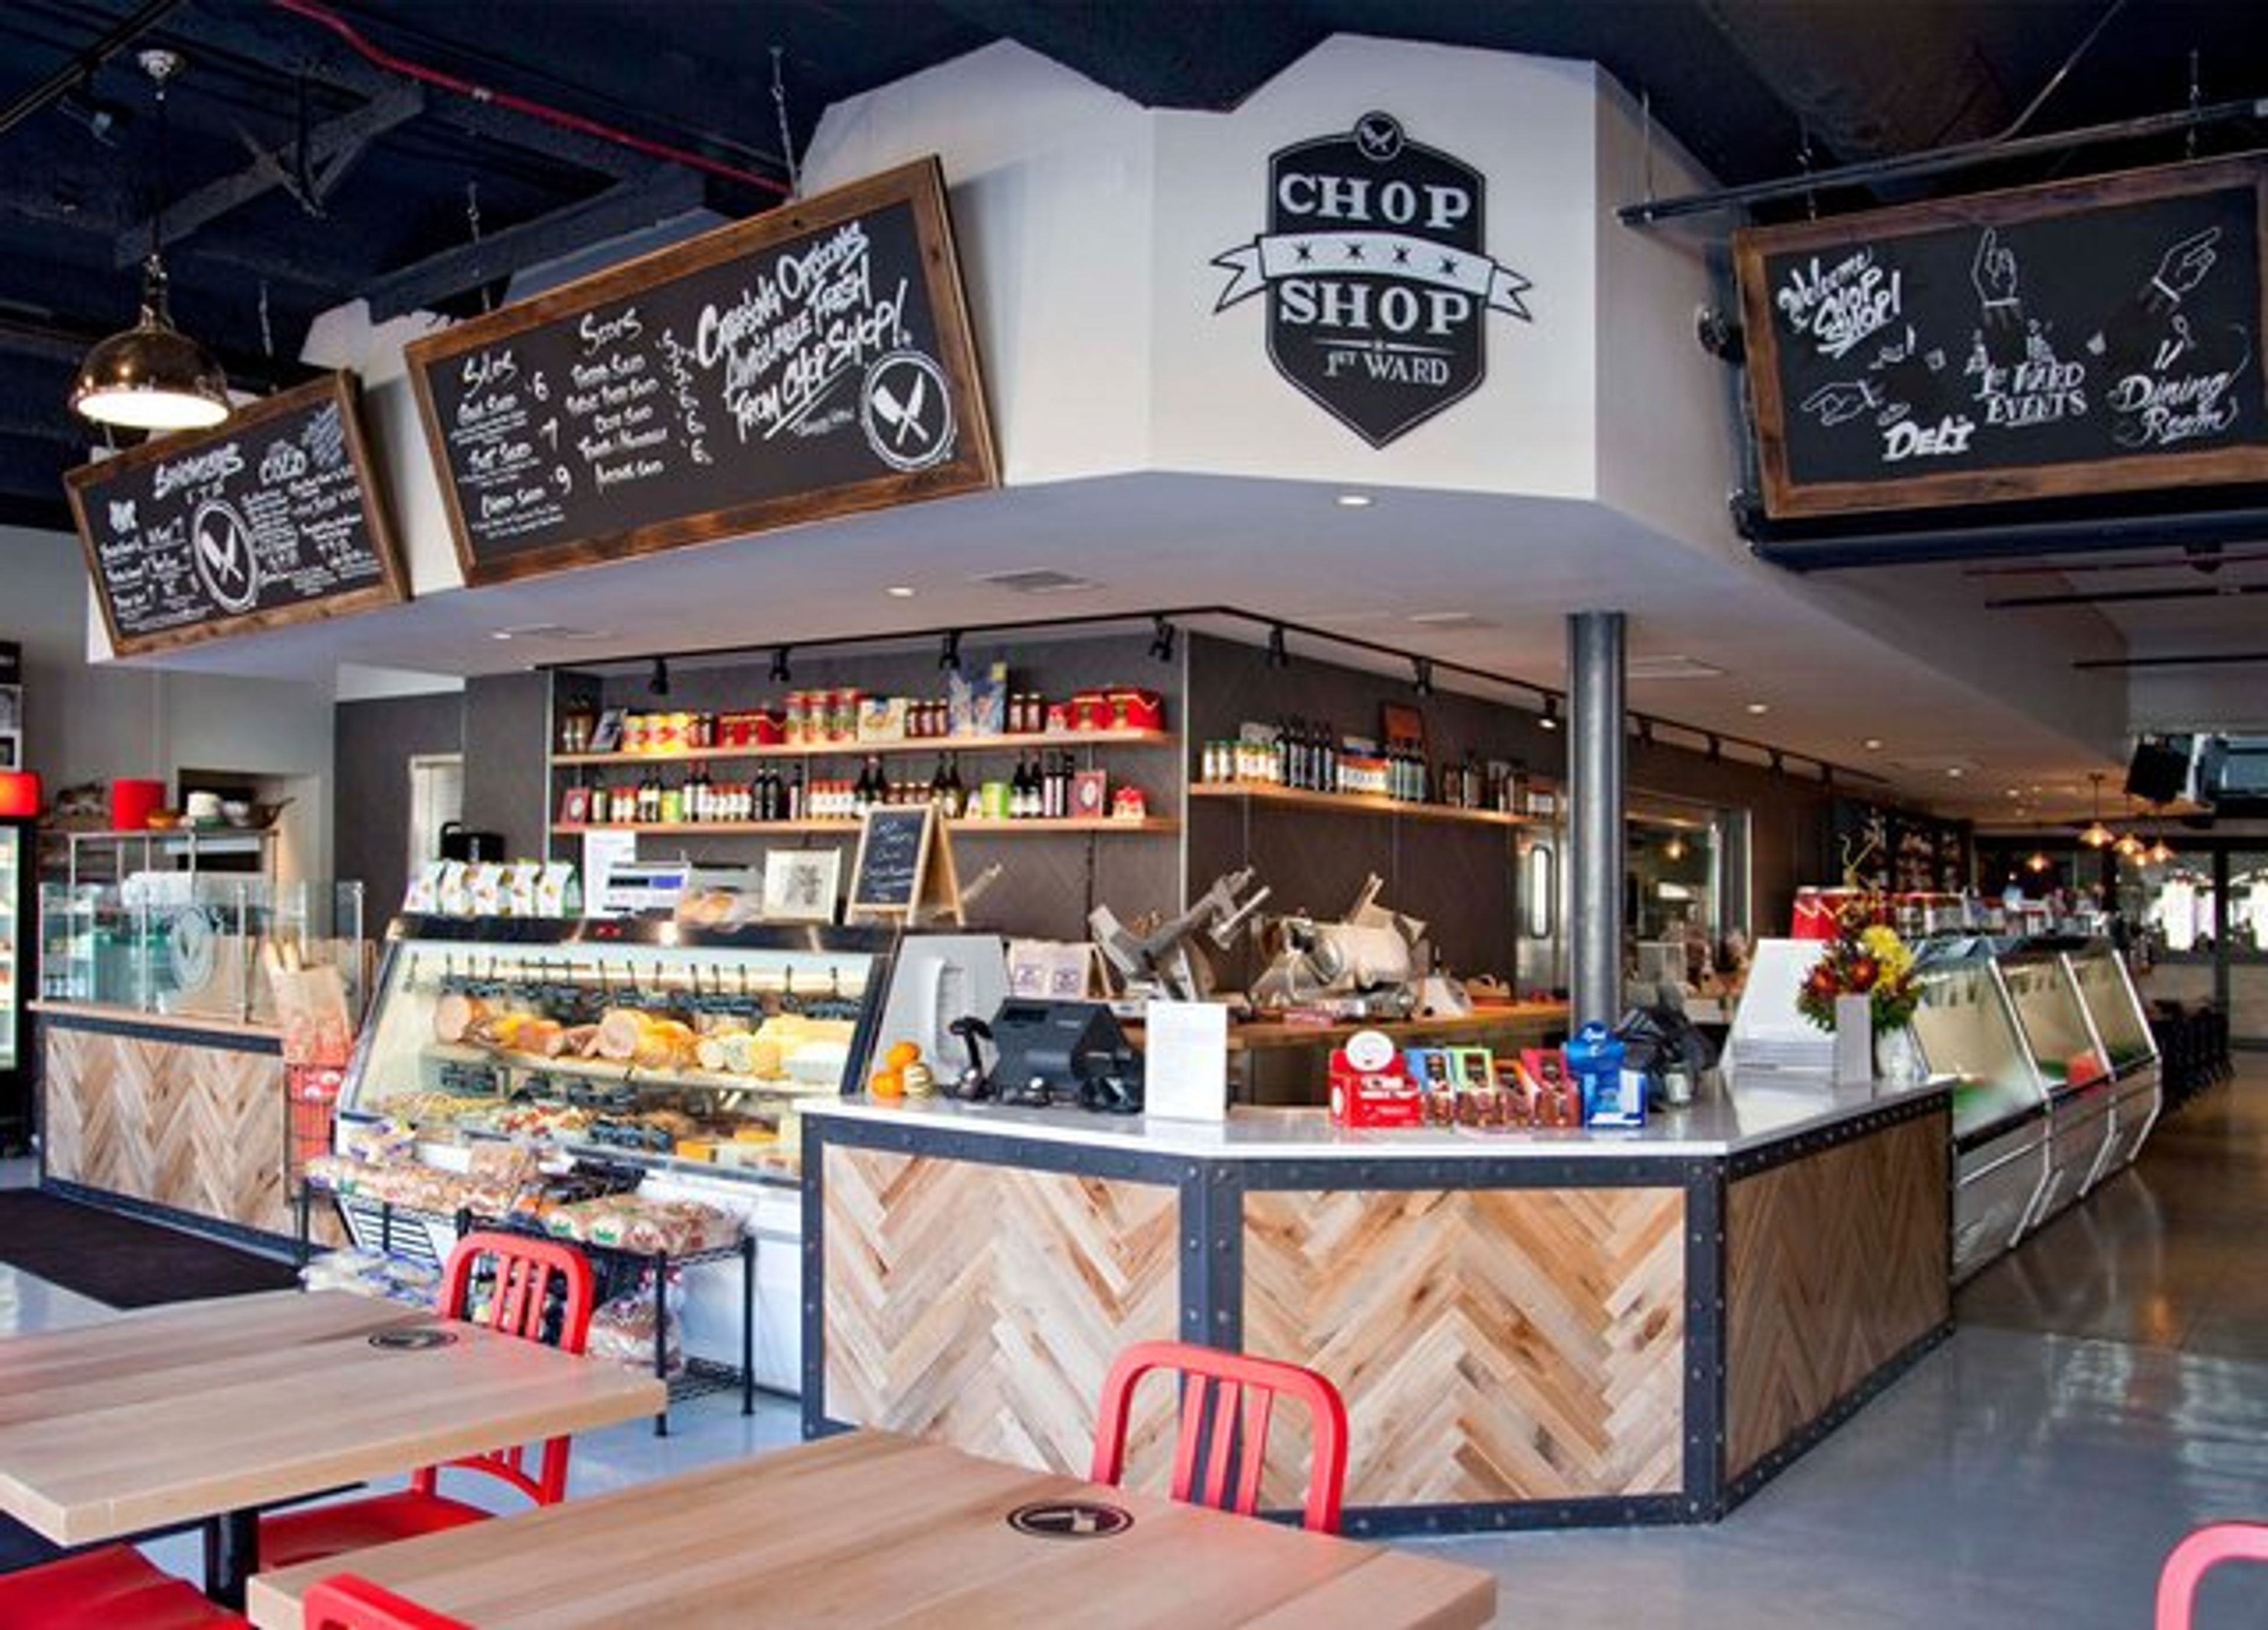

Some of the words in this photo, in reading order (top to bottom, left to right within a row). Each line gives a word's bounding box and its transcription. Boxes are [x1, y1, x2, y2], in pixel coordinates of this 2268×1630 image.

[1278, 172, 1470, 229] CHOP
[1279, 279, 1470, 334] SHOP
[1361, 351, 1451, 386] WARD
[1986, 389, 2088, 426] EVENTS
